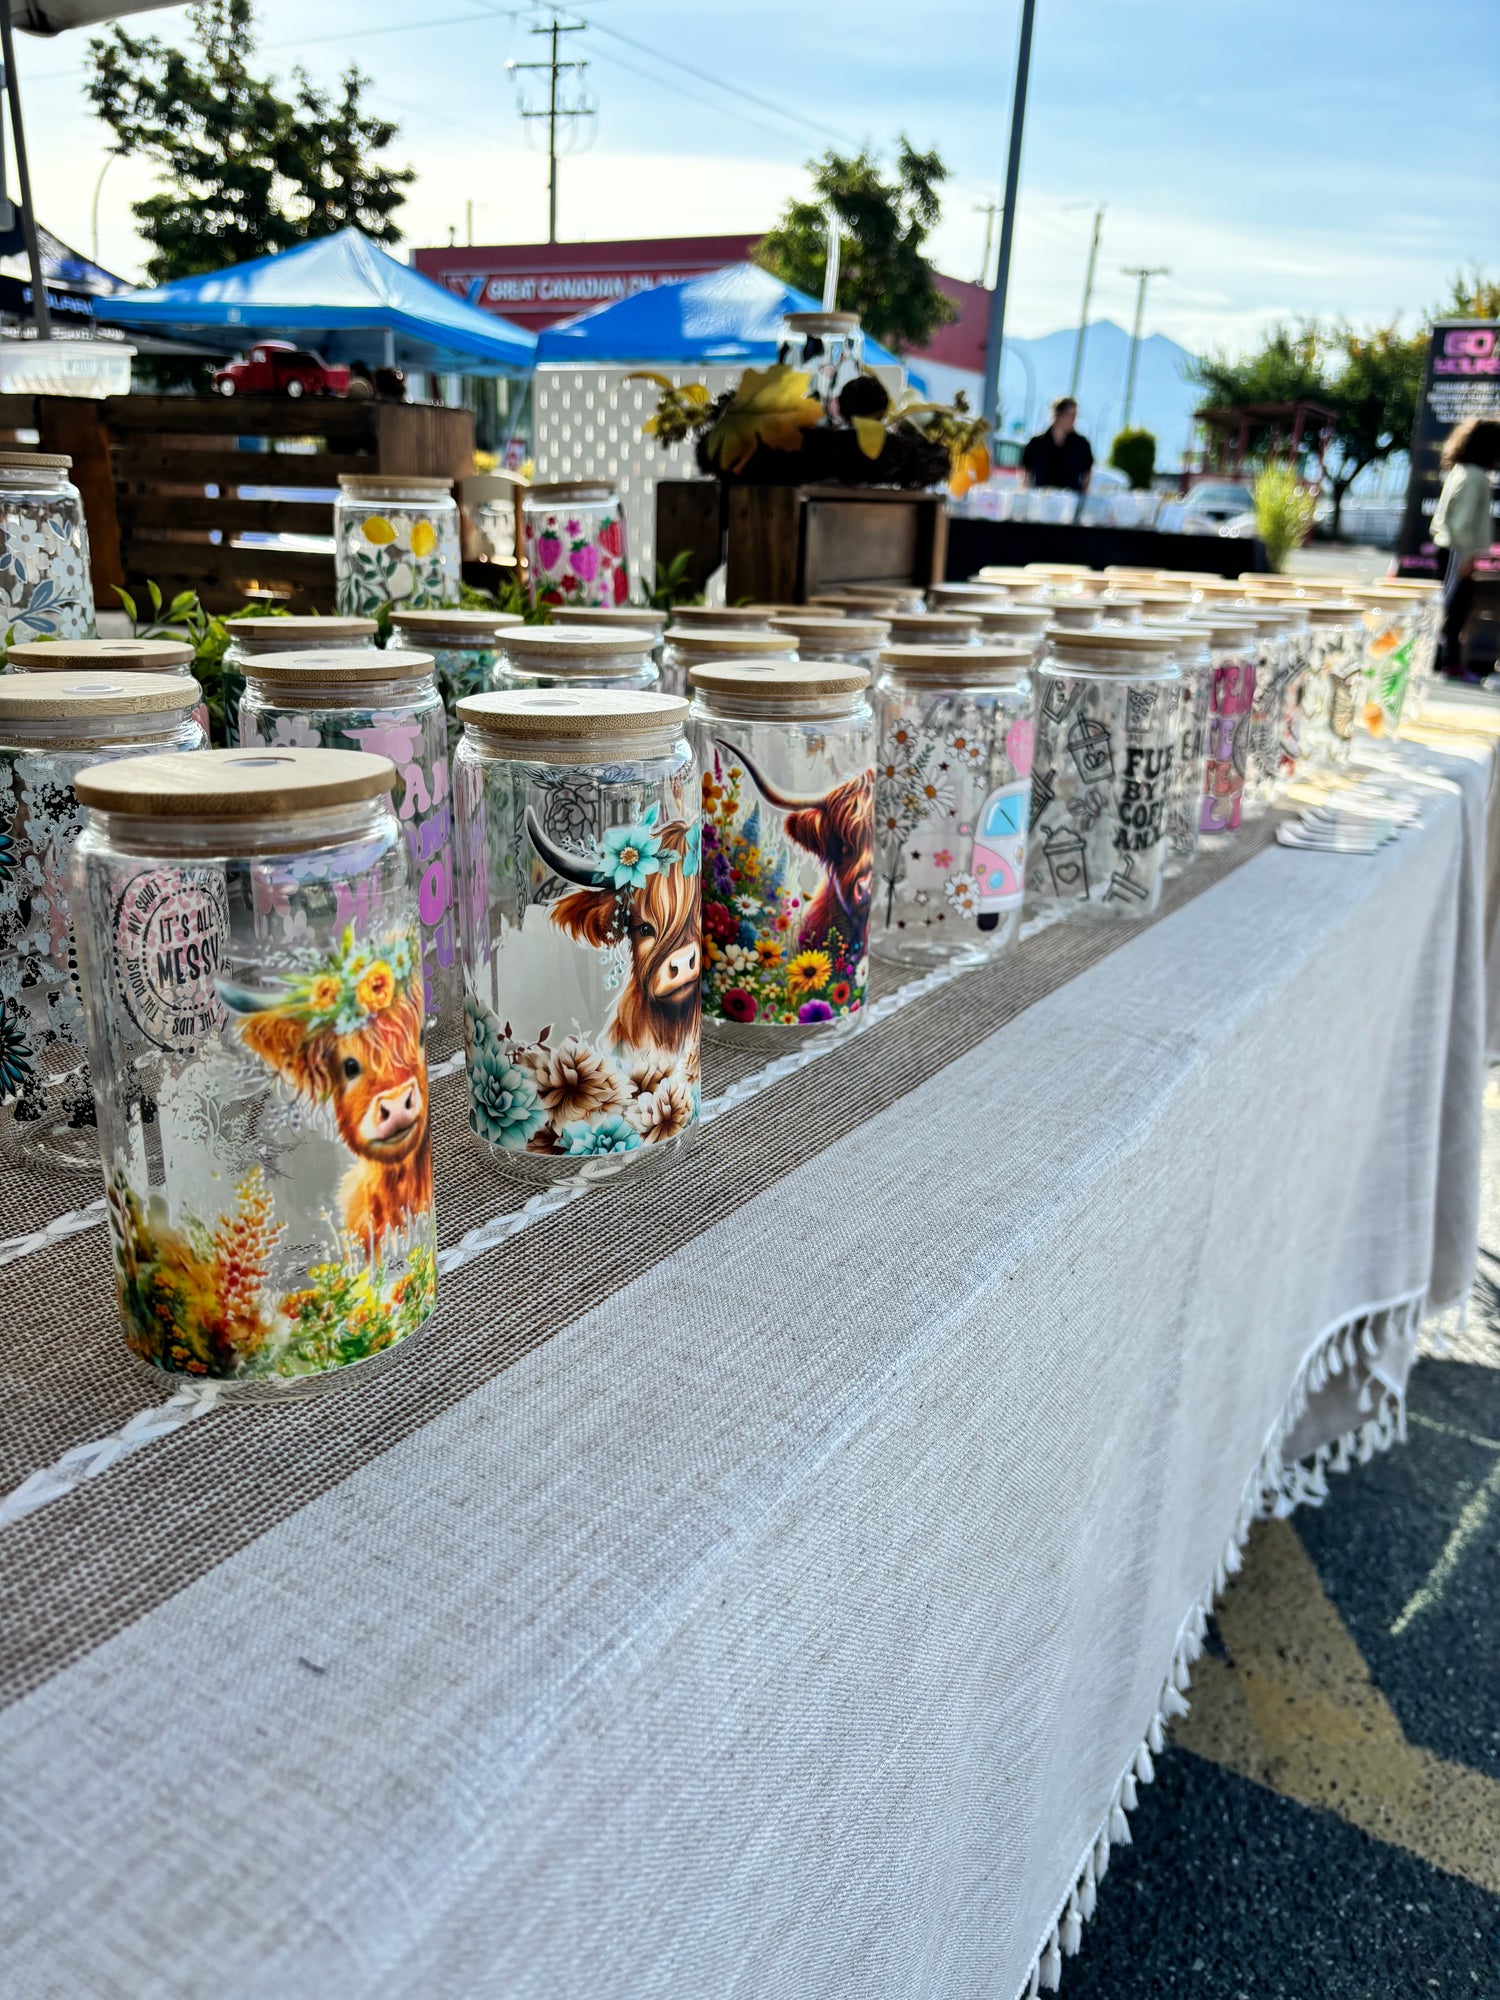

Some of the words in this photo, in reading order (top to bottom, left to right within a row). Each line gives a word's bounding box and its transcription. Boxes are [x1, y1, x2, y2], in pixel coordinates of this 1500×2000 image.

[538, 273, 627, 299] CANADIAN
[135, 878, 163, 913] SHIRT
[160, 911, 190, 944] IT'S
[197, 905, 213, 934] ALL
[172, 1014, 195, 1036] KIDS
